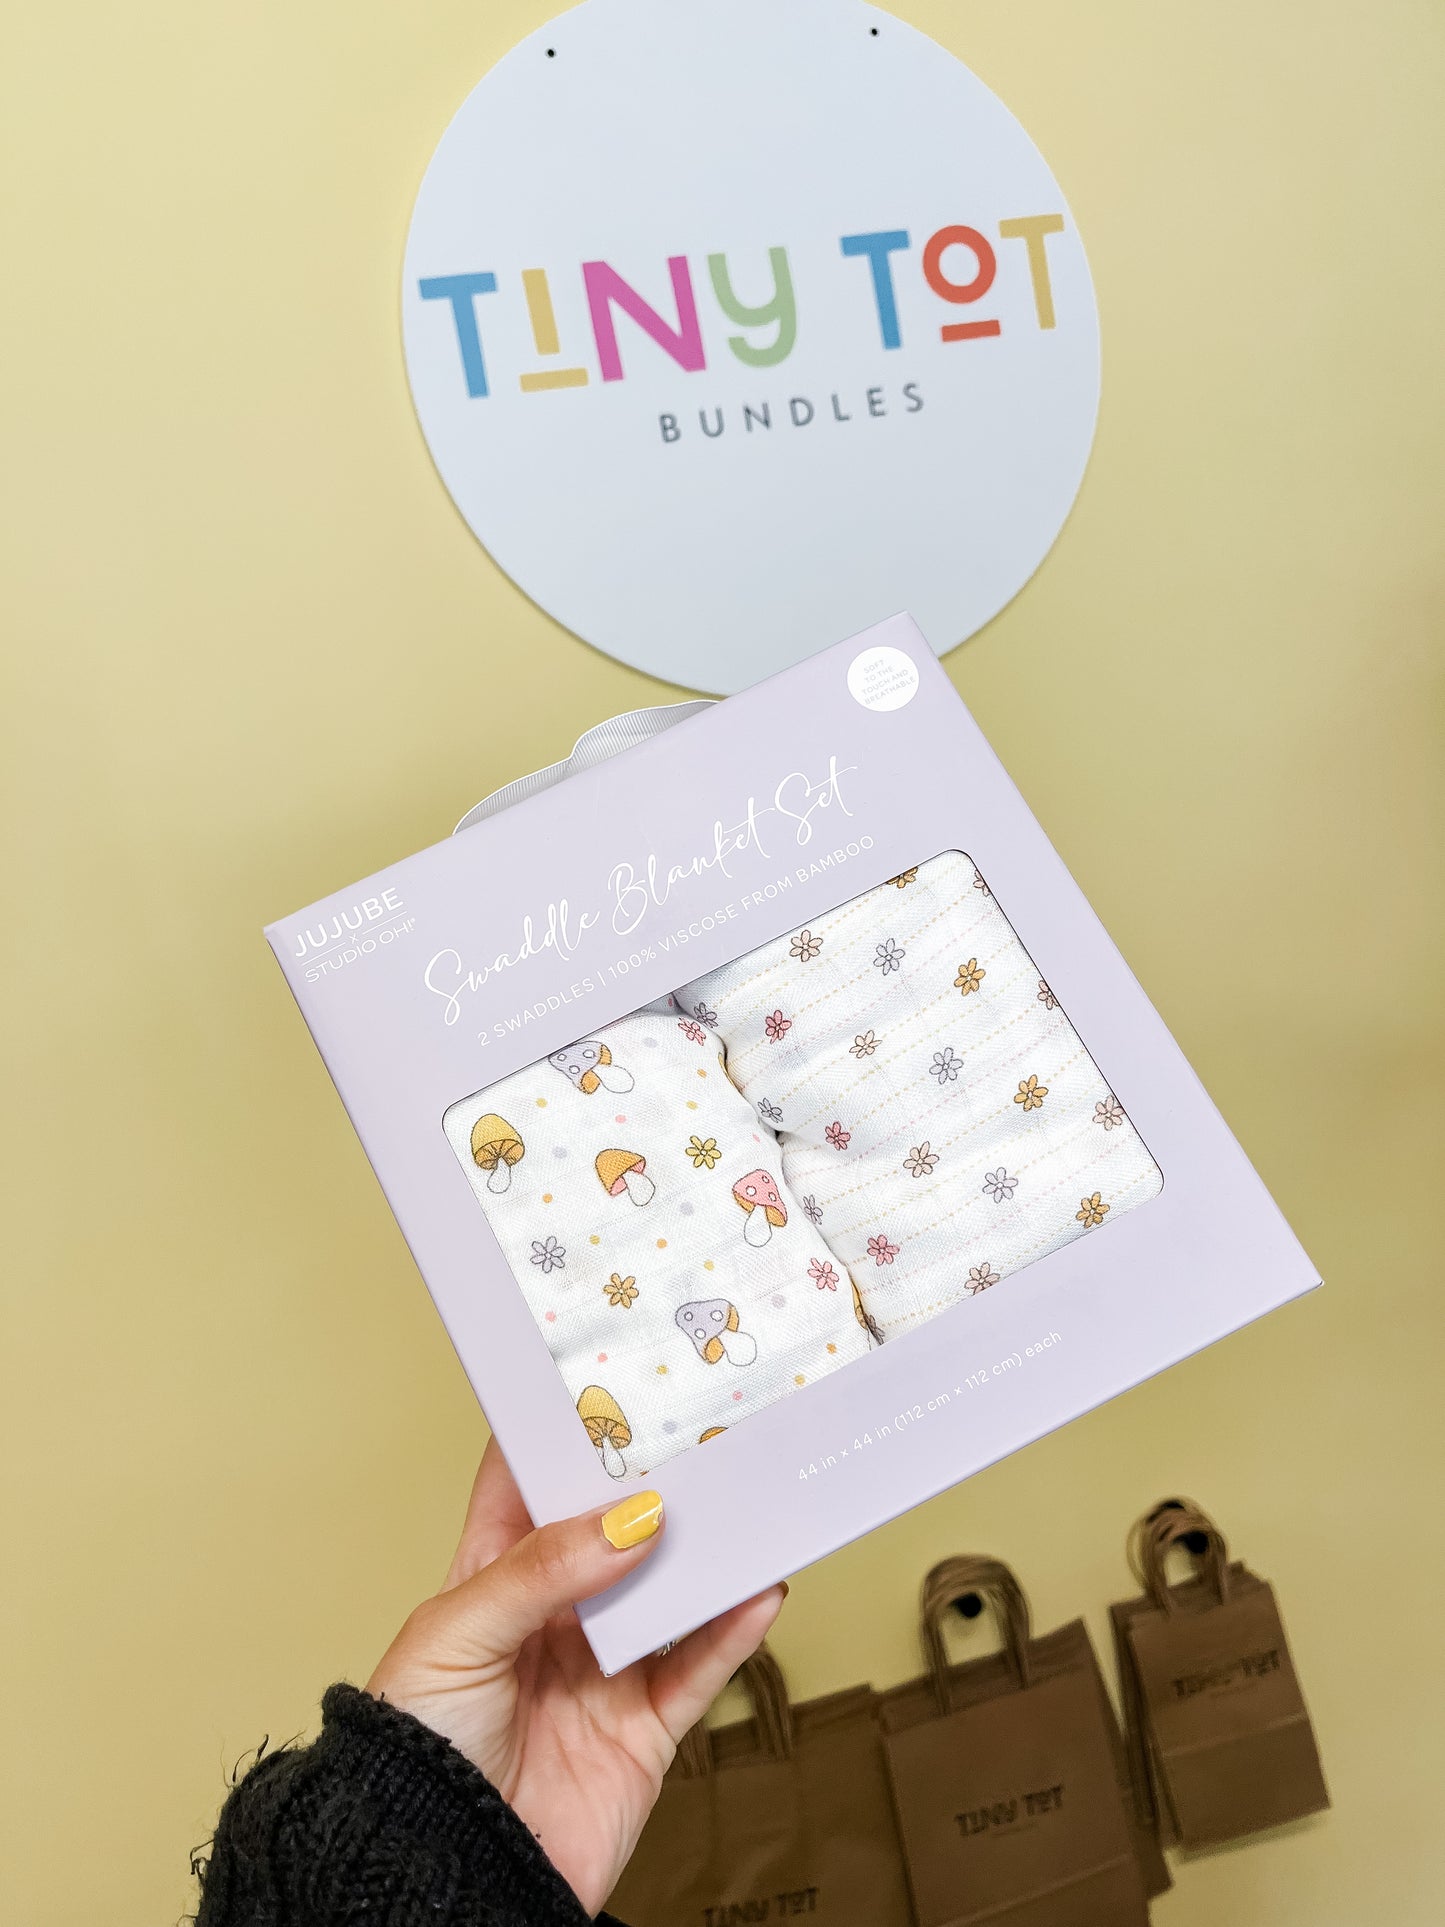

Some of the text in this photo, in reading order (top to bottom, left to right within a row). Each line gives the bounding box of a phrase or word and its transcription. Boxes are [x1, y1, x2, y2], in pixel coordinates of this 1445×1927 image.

[418, 213, 1064, 398] TINY TOT
[659, 383, 925, 443] BUNDLES
[862, 669, 908, 695] TOUCH AND
[864, 660, 884, 674] SOFT
[865, 676, 916, 705] BREATHABLE
[877, 665, 893, 678] THE
[424, 755, 857, 1026] Swaddle Blanket Set
[295, 887, 404, 957] JUJUBE
[478, 1031, 490, 1046] 2
[493, 978, 594, 1038] SWADDLES
[608, 945, 656, 979] 100%
[658, 905, 738, 952] VISCOSE
[741, 876, 793, 911] FROM
[796, 835, 874, 882] BAMBOO
[305, 940, 376, 983] STUDIO
[798, 1463, 818, 1481] 44
[821, 1454, 837, 1470] in
[853, 1433, 873, 1452] 44
[876, 1423, 892, 1440] in
[894, 1404, 925, 1432] (112
[927, 1393, 951, 1412] cm
[964, 1369, 990, 1390] 112
[992, 1352, 1023, 1376] cm)
[1024, 1331, 1062, 1358] each
